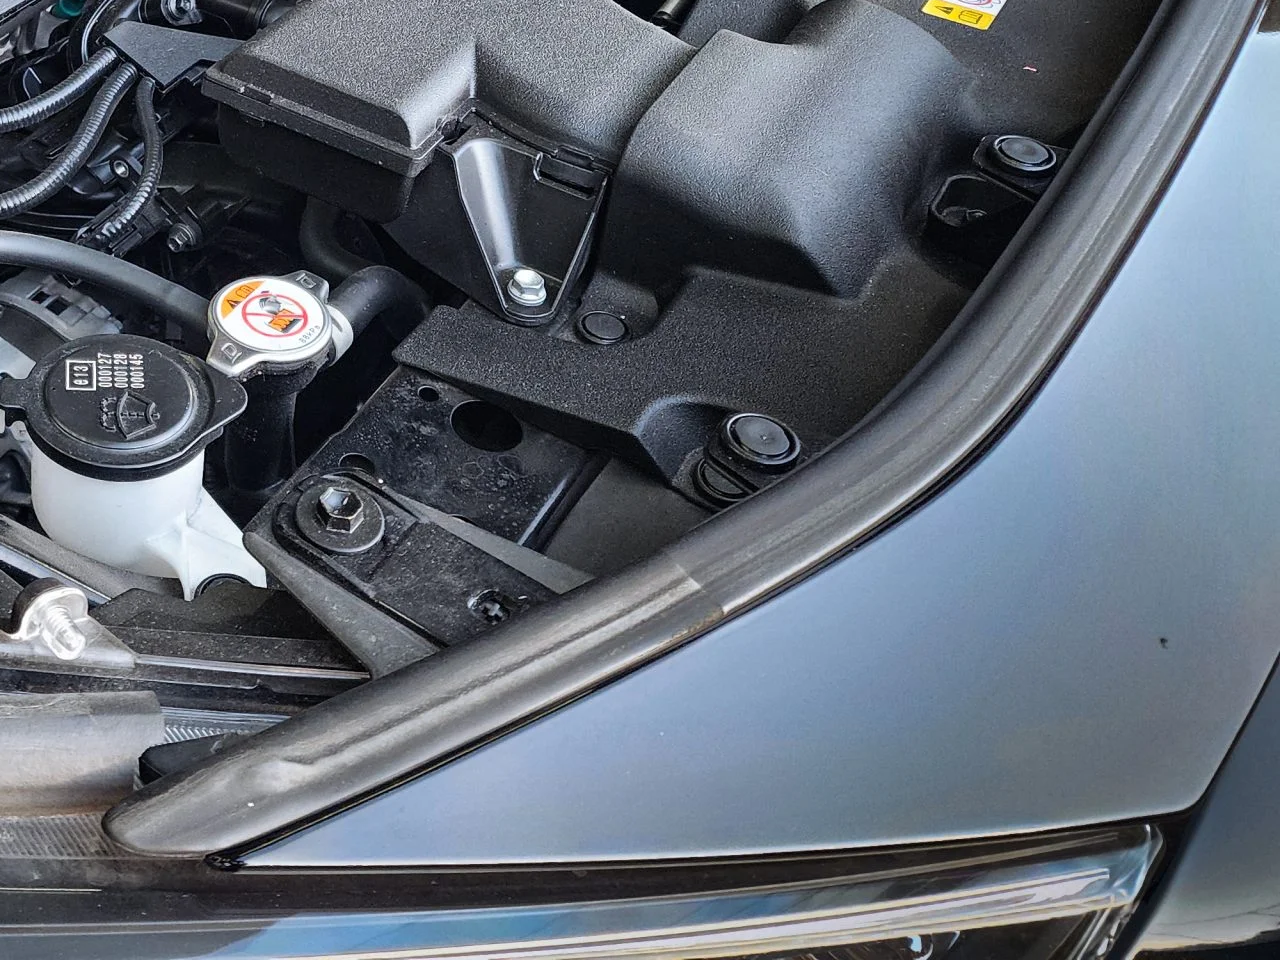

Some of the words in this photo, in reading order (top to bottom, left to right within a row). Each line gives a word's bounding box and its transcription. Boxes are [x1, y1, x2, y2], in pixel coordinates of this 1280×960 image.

[73, 365, 89, 385] e13
[97, 352, 113, 388] 000127
[113, 353, 129, 388] 000128
[129, 354, 145, 389] 000145
